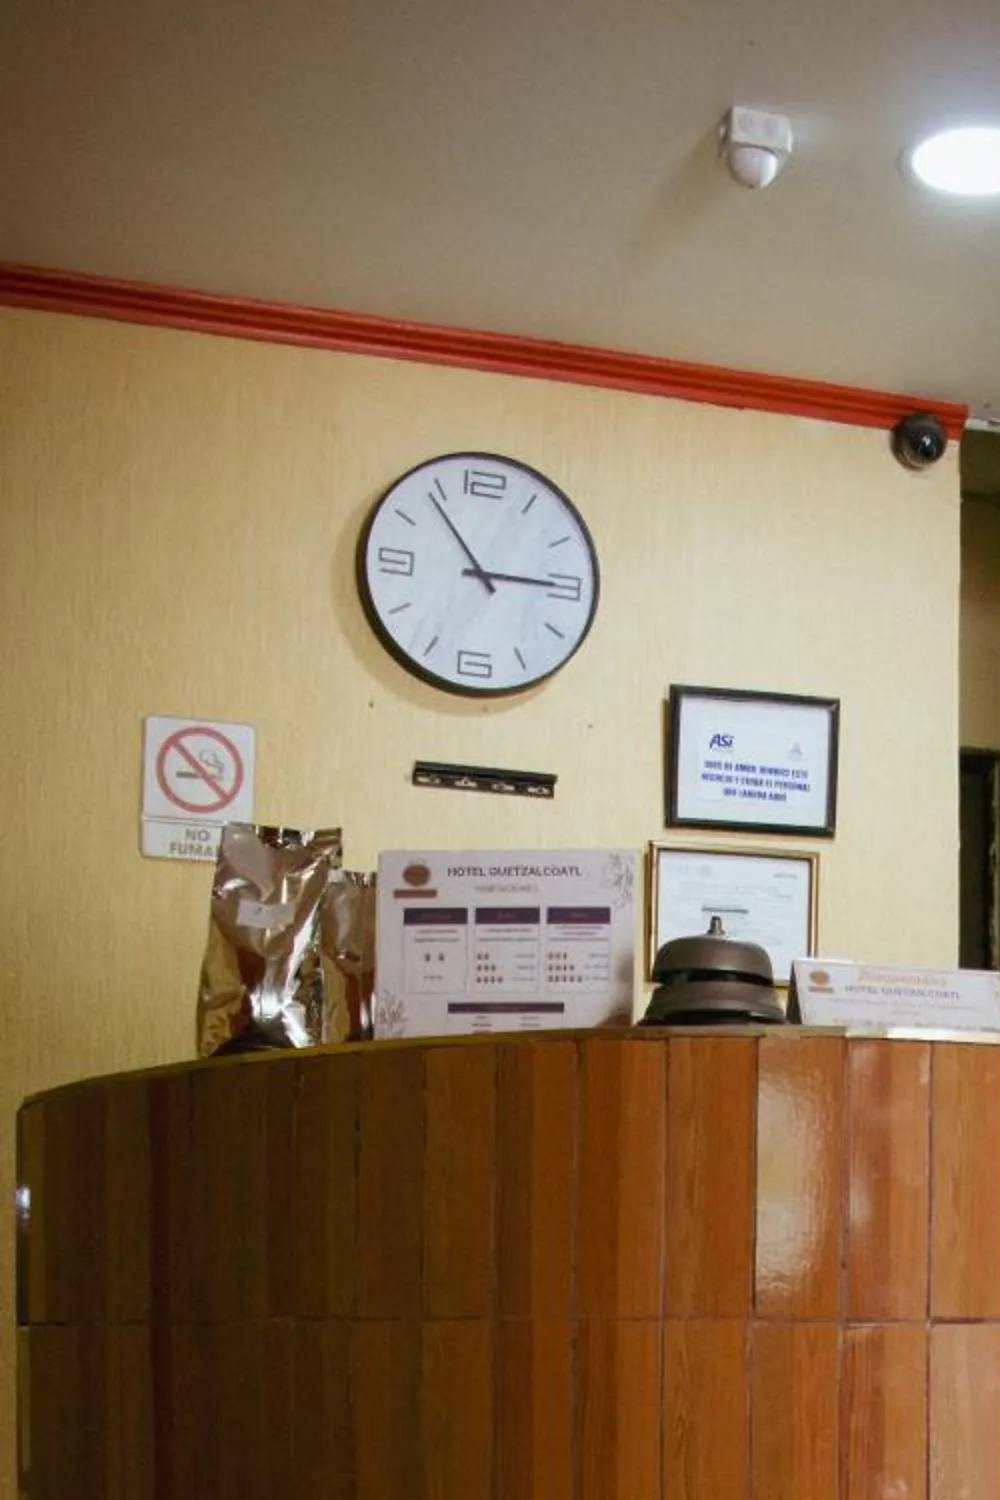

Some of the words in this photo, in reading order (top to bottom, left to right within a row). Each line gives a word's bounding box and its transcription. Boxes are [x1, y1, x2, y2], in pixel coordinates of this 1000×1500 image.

[464, 469, 507, 499] 12
[378, 547, 415, 577] 9
[547, 573, 582, 602] 3
[457, 650, 493, 679] 6
[185, 828, 211, 842] NO
[447, 866, 486, 877] HOTEL
